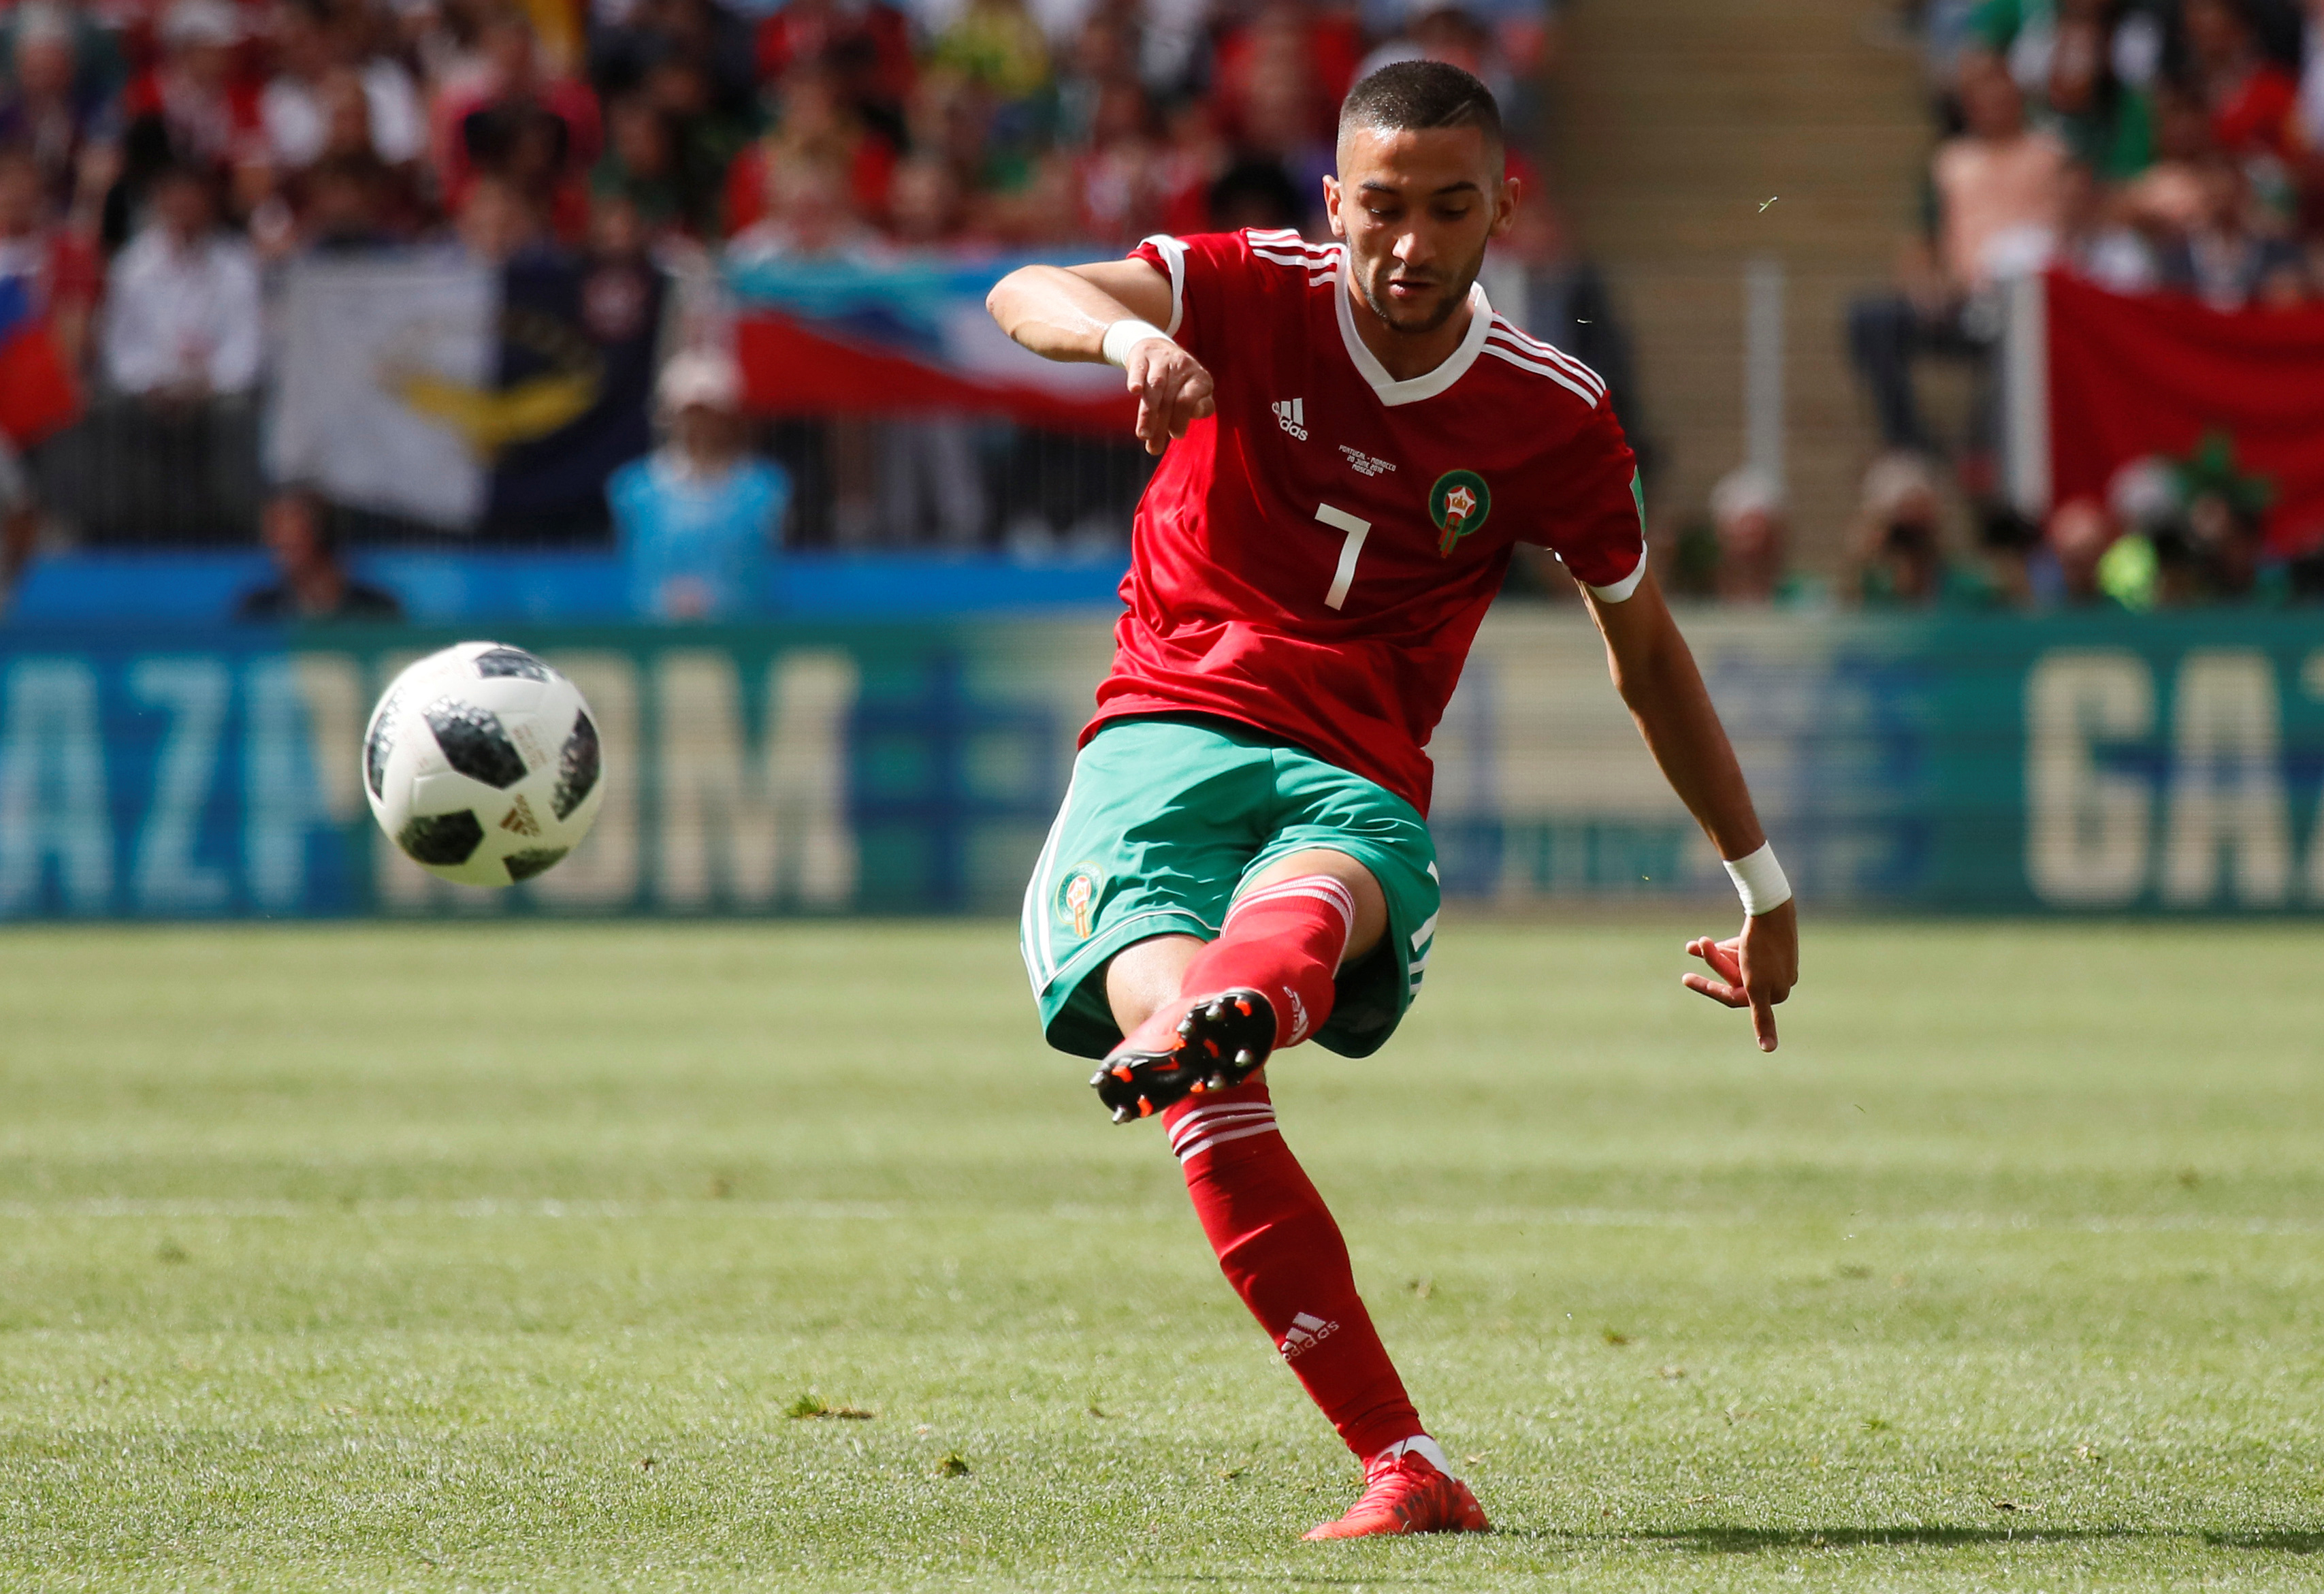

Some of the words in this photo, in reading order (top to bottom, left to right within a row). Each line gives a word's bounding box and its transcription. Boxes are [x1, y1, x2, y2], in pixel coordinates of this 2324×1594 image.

[1338, 445, 1366, 460] PORTUGAL
[1370, 457, 1396, 472] MOROCCO
[1346, 455, 1355, 463] 20
[1355, 458, 1370, 468] JUNE
[1370, 464, 1385, 474] 2018
[1351, 464, 1375, 477] MOSCOW
[1314, 503, 1372, 611] 7
[2022, 647, 2324, 909] GA
[1282, 1320, 1340, 1362] adidas
